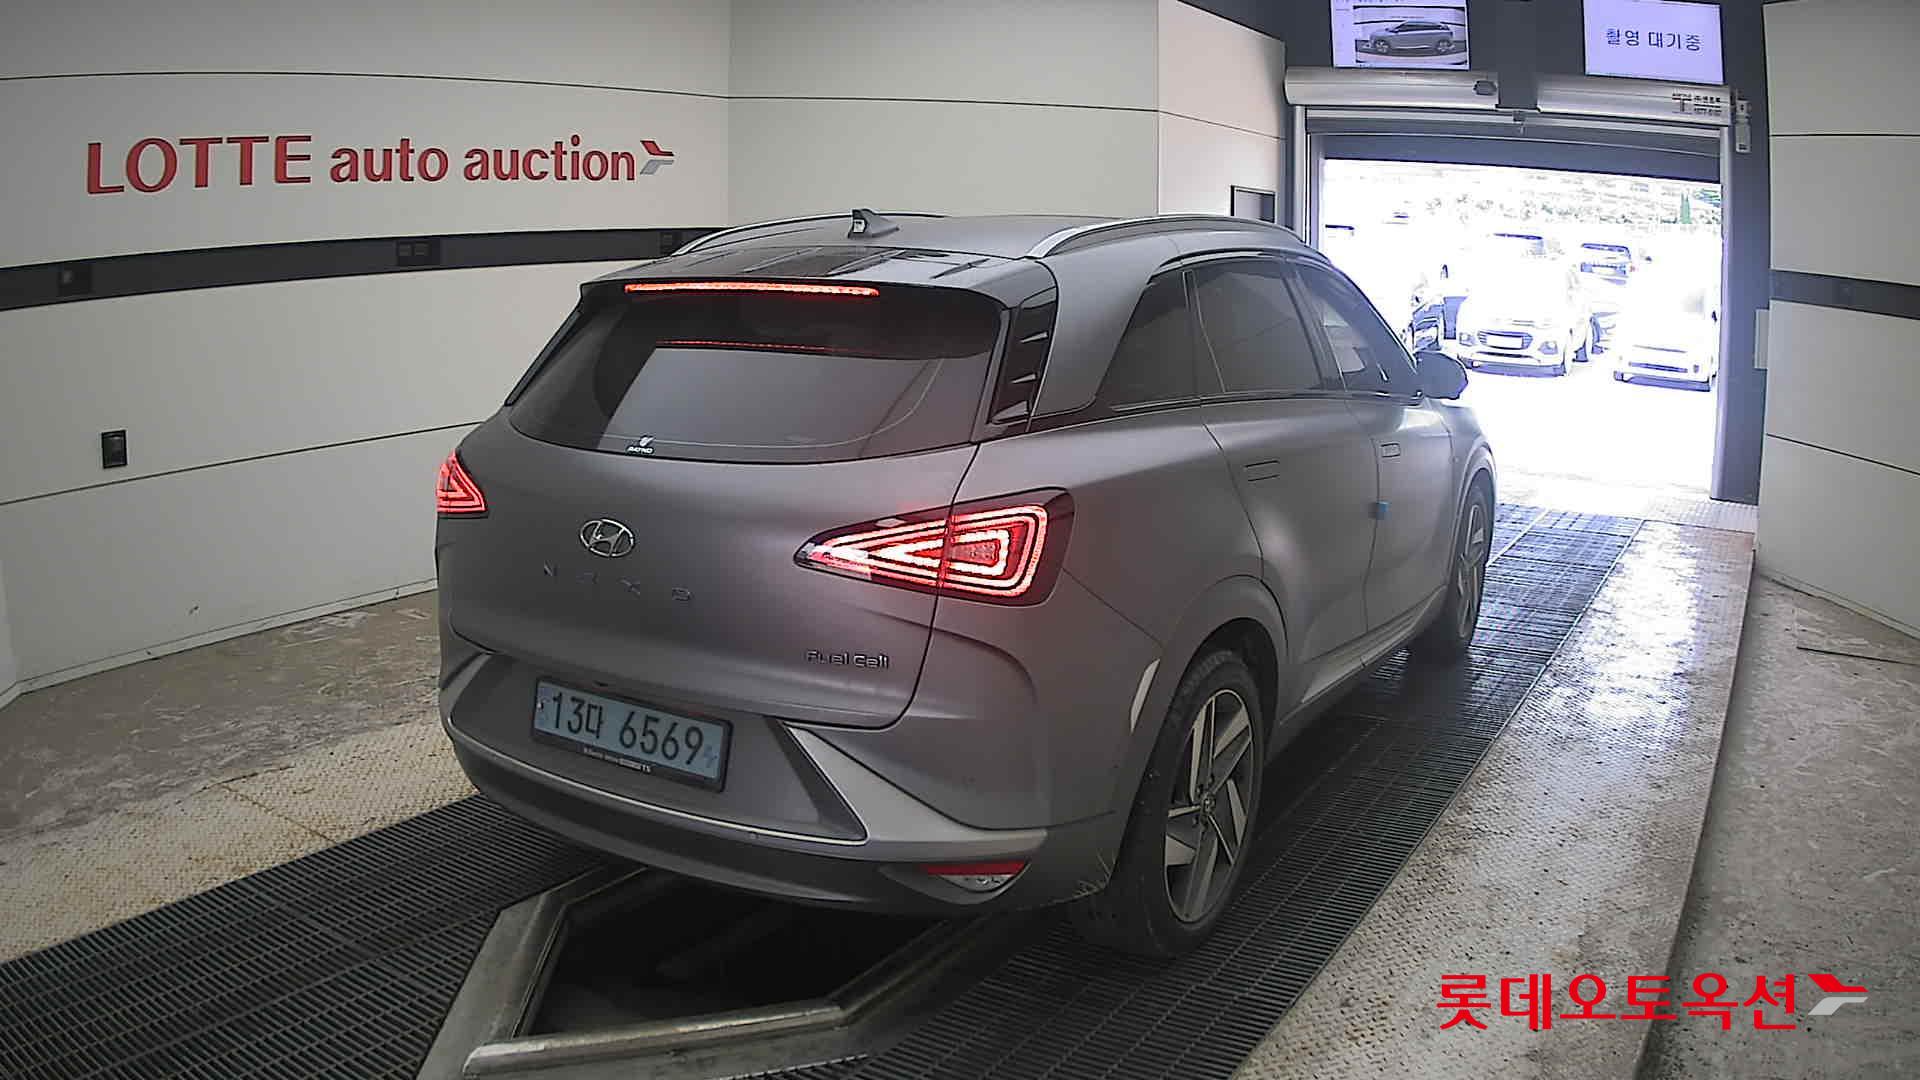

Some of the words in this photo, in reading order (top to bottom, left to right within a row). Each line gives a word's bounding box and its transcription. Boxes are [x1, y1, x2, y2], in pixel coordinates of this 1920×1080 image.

[87, 135, 312, 194] LOTTE
[330, 138, 449, 182] auto
[463, 134, 635, 181] auction
[806, 649, 850, 666] Fuel
[853, 653, 889, 669] Cell
[552, 692, 604, 739] 13마
[619, 711, 704, 766] 6569
